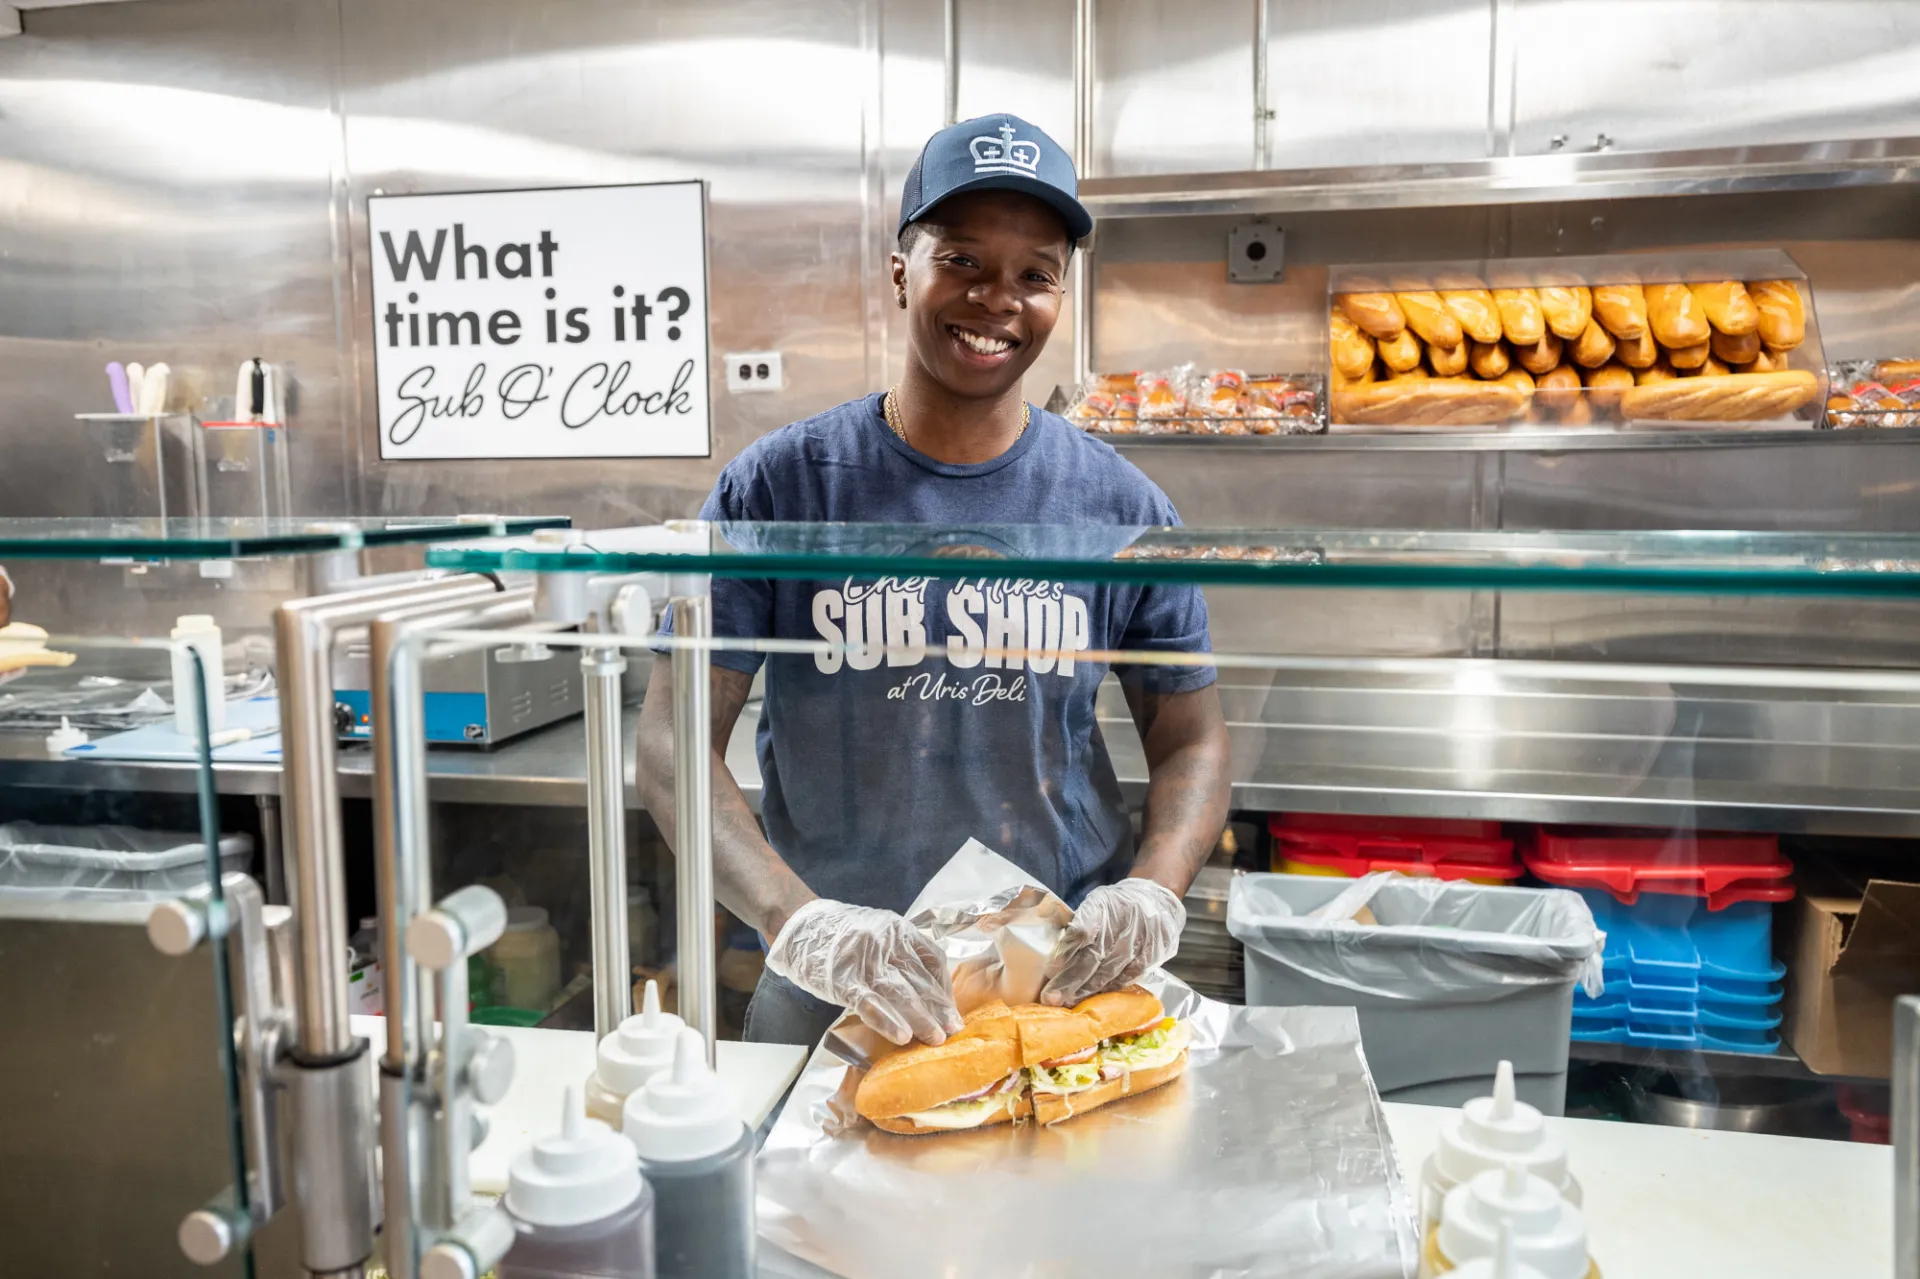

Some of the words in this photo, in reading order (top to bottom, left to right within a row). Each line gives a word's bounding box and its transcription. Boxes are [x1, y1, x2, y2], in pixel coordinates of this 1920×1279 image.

[379, 223, 558, 282] What
[385, 292, 521, 347] time
[545, 287, 590, 343] is
[613, 285, 691, 341] it?
[389, 363, 486, 445] Sub
[561, 359, 694, 429] Clock
[812, 588, 926, 674] SUB
[946, 585, 1089, 677] SHOP
[887, 677, 914, 700] at
[912, 673, 969, 701] Uris
[972, 673, 1027, 706] Deli
